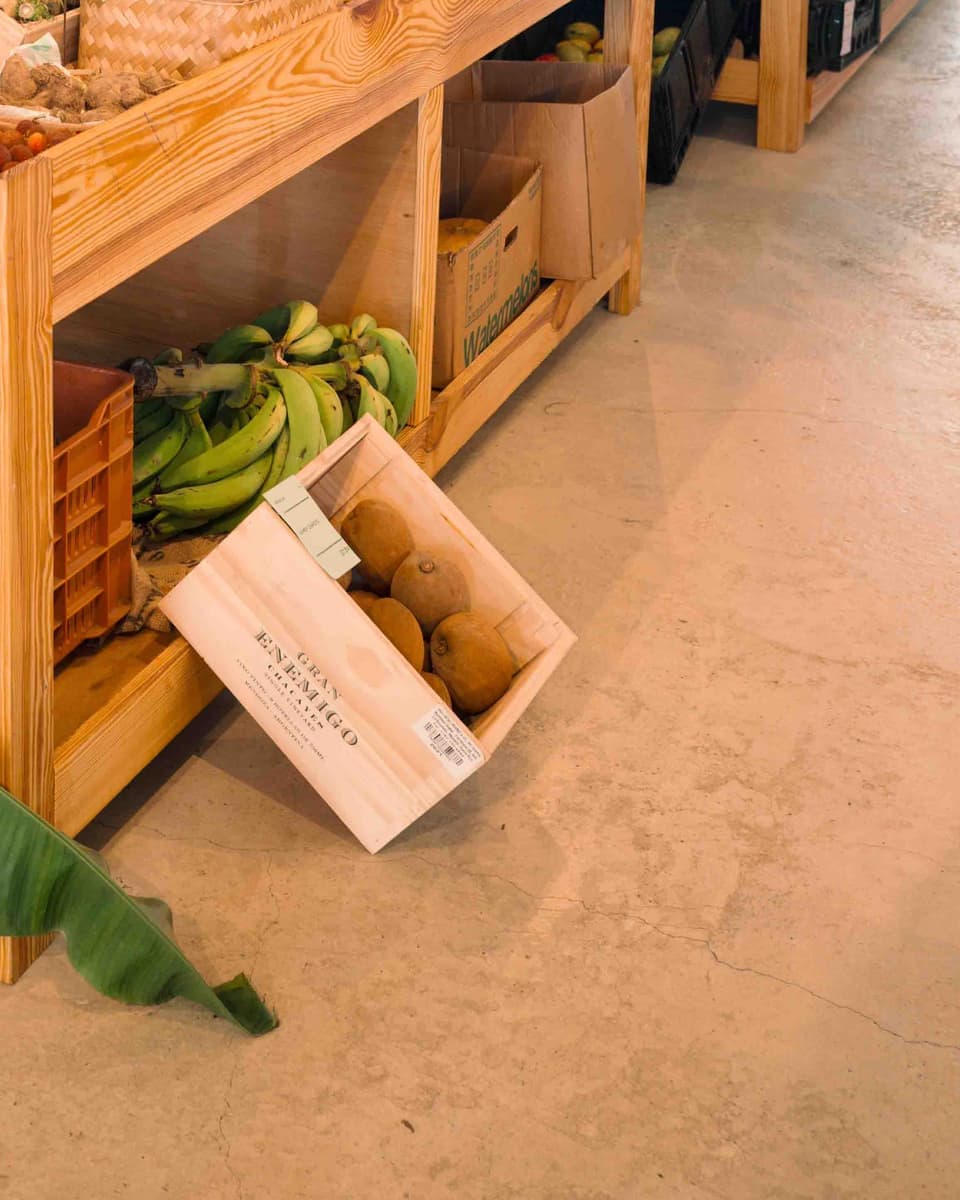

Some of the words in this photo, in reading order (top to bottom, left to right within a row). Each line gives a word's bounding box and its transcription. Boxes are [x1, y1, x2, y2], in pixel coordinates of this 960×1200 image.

[463, 258, 539, 369] Watermelons
[254, 629, 359, 747] ENEMIGO
[267, 664, 324, 729] CHACAYES
[296, 651, 343, 701] GRAN
[286, 697, 316, 732] VINEYARD
